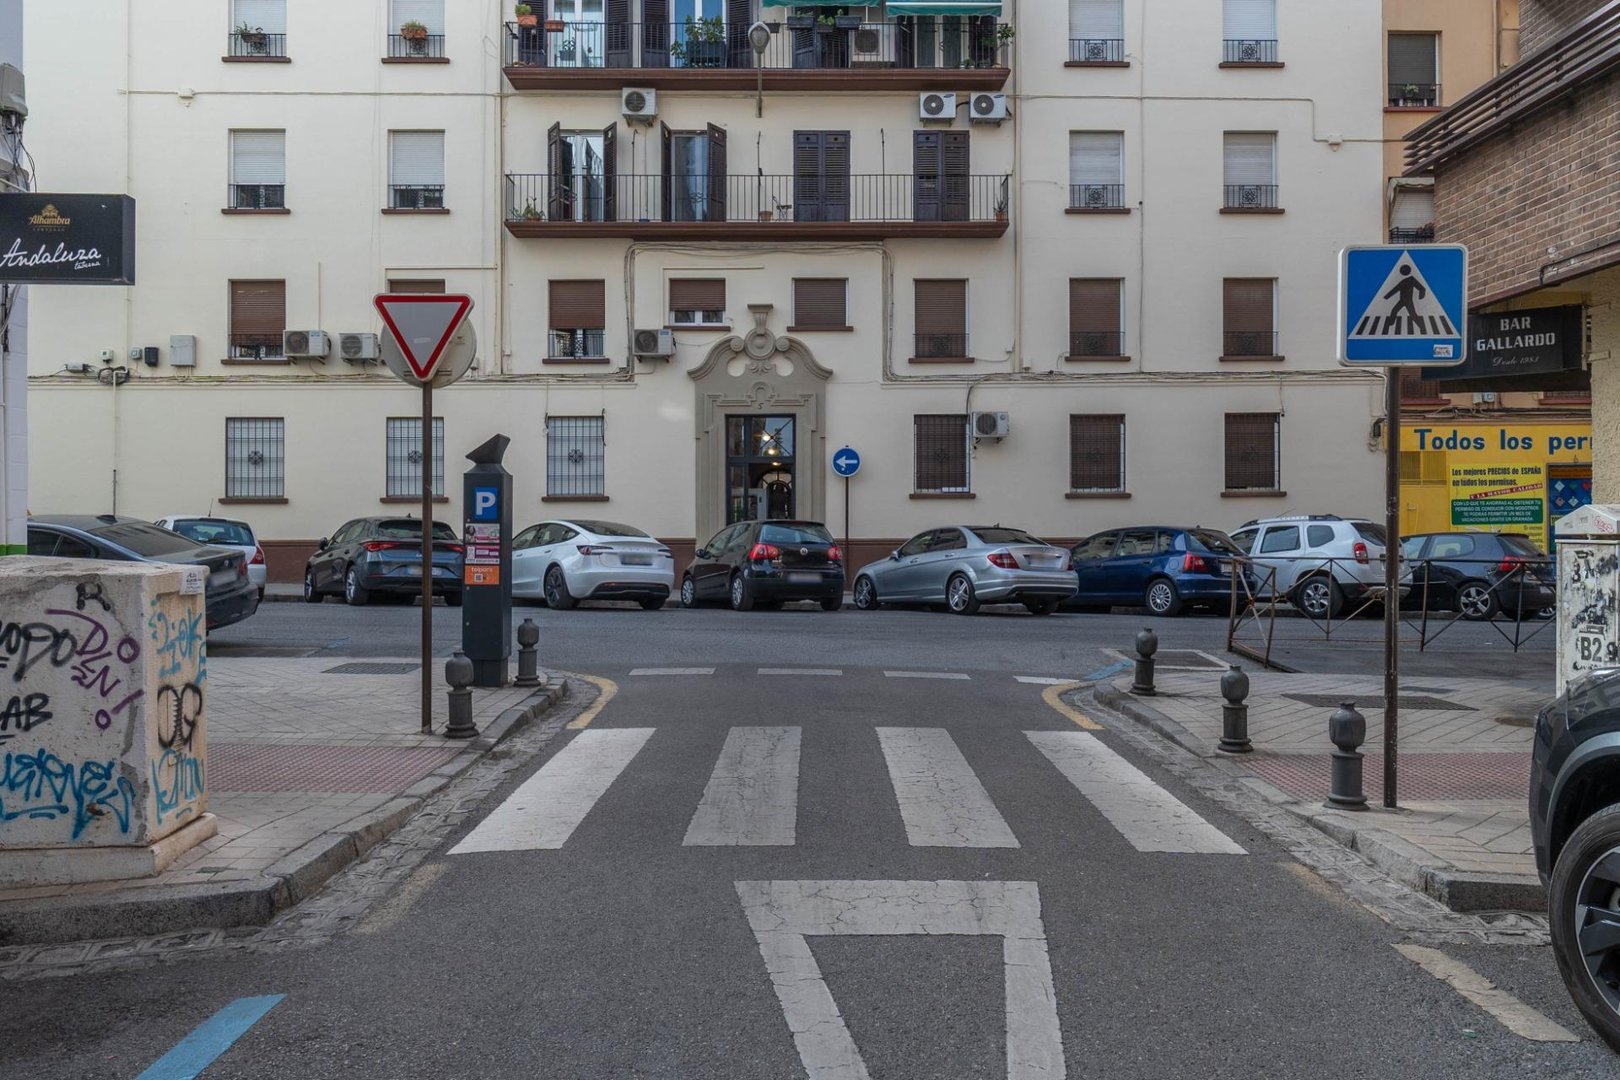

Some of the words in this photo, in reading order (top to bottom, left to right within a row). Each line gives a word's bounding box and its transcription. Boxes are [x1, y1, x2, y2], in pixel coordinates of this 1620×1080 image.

[28, 214, 70, 225] Alhambra
[0, 238, 101, 267] Andaluza
[1500, 316, 1531, 331] BAR
[1476, 332, 1556, 351] GALLARDO
[1414, 428, 1485, 450] Todos
[1500, 429, 1533, 450] los
[1548, 436, 1592, 455] per
[1521, 466, 1541, 474] ESPAÑA
[476, 492, 496, 515] P
